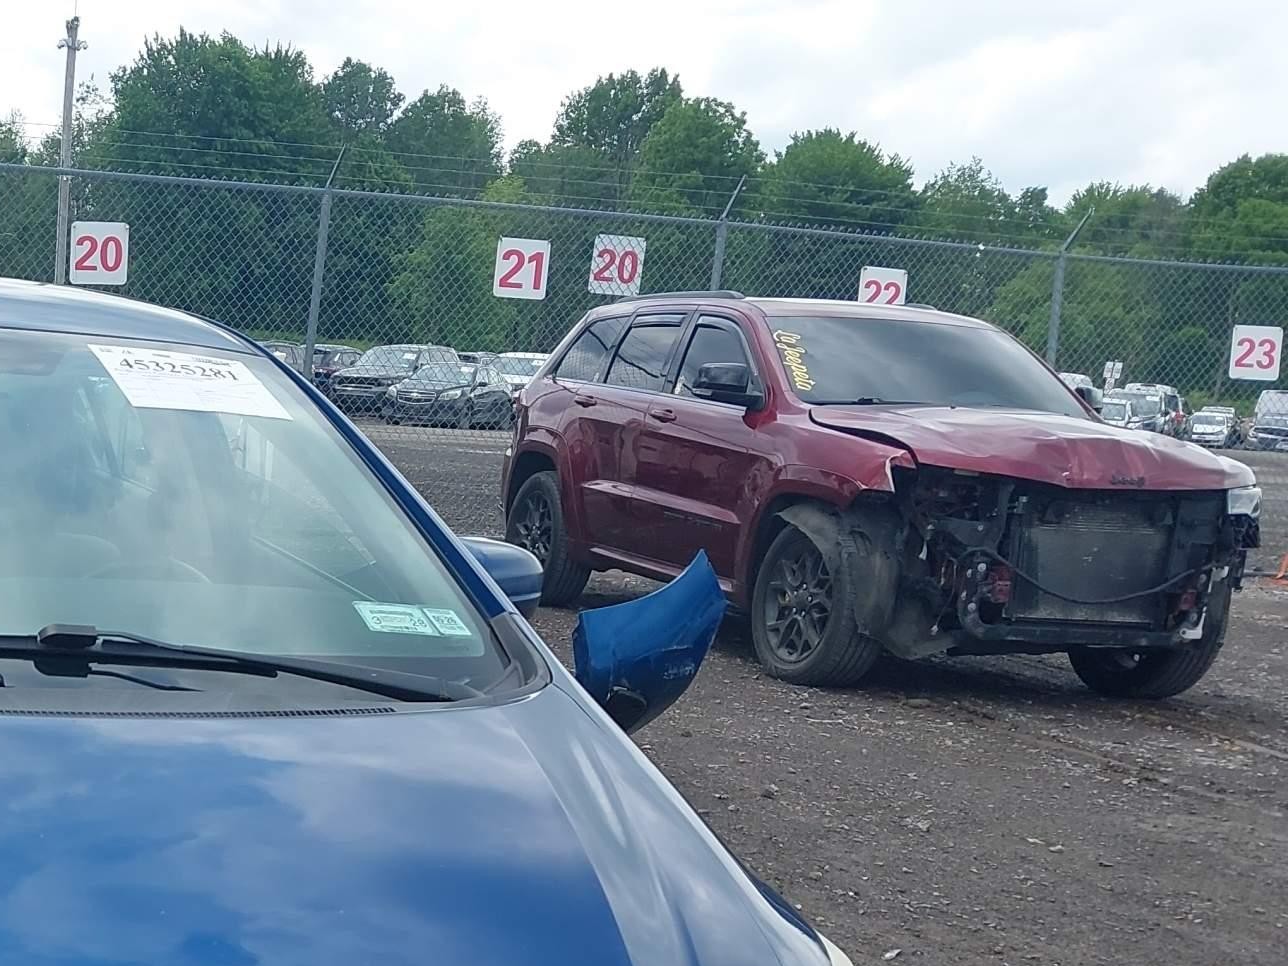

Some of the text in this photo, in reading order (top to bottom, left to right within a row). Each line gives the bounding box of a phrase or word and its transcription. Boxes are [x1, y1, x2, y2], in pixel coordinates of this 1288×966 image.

[75, 235, 123, 272] 20
[498, 248, 545, 290] 21
[593, 249, 639, 284] 20
[864, 280, 901, 304] 22
[118, 357, 240, 383] 45325281
[1234, 338, 1276, 369] 23
